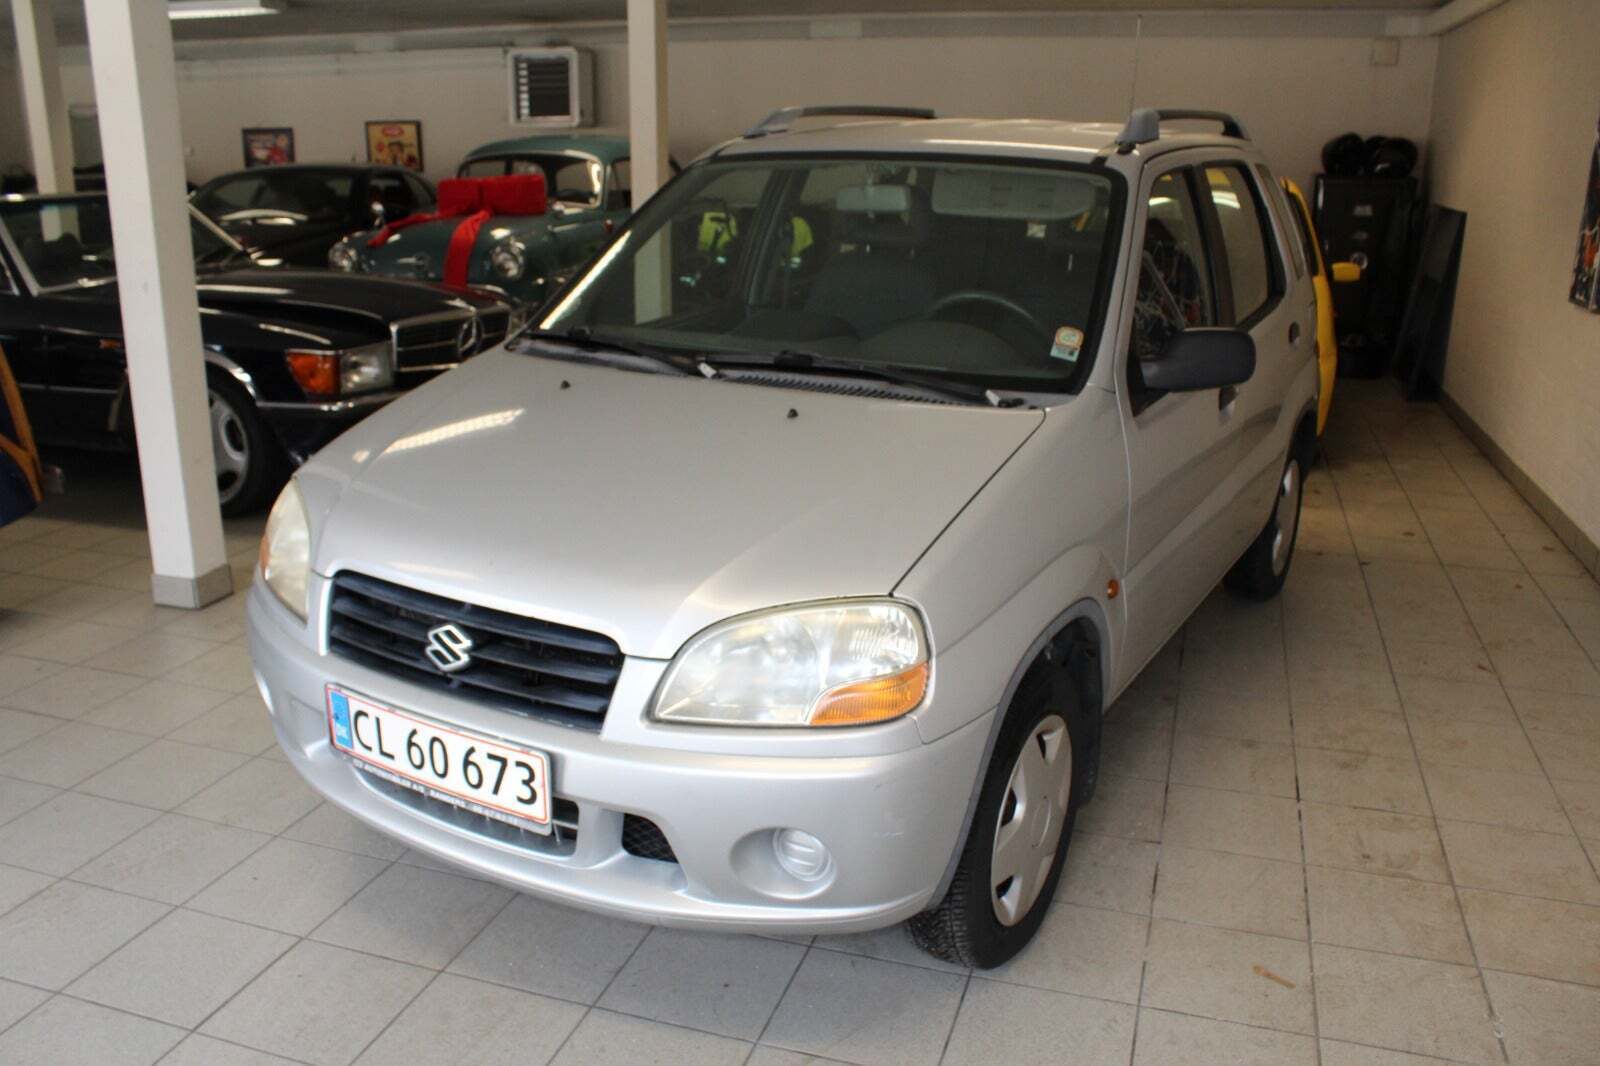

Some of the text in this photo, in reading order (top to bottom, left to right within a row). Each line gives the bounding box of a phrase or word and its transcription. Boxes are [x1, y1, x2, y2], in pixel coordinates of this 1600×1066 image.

[353, 709, 538, 806] CL 60 673
